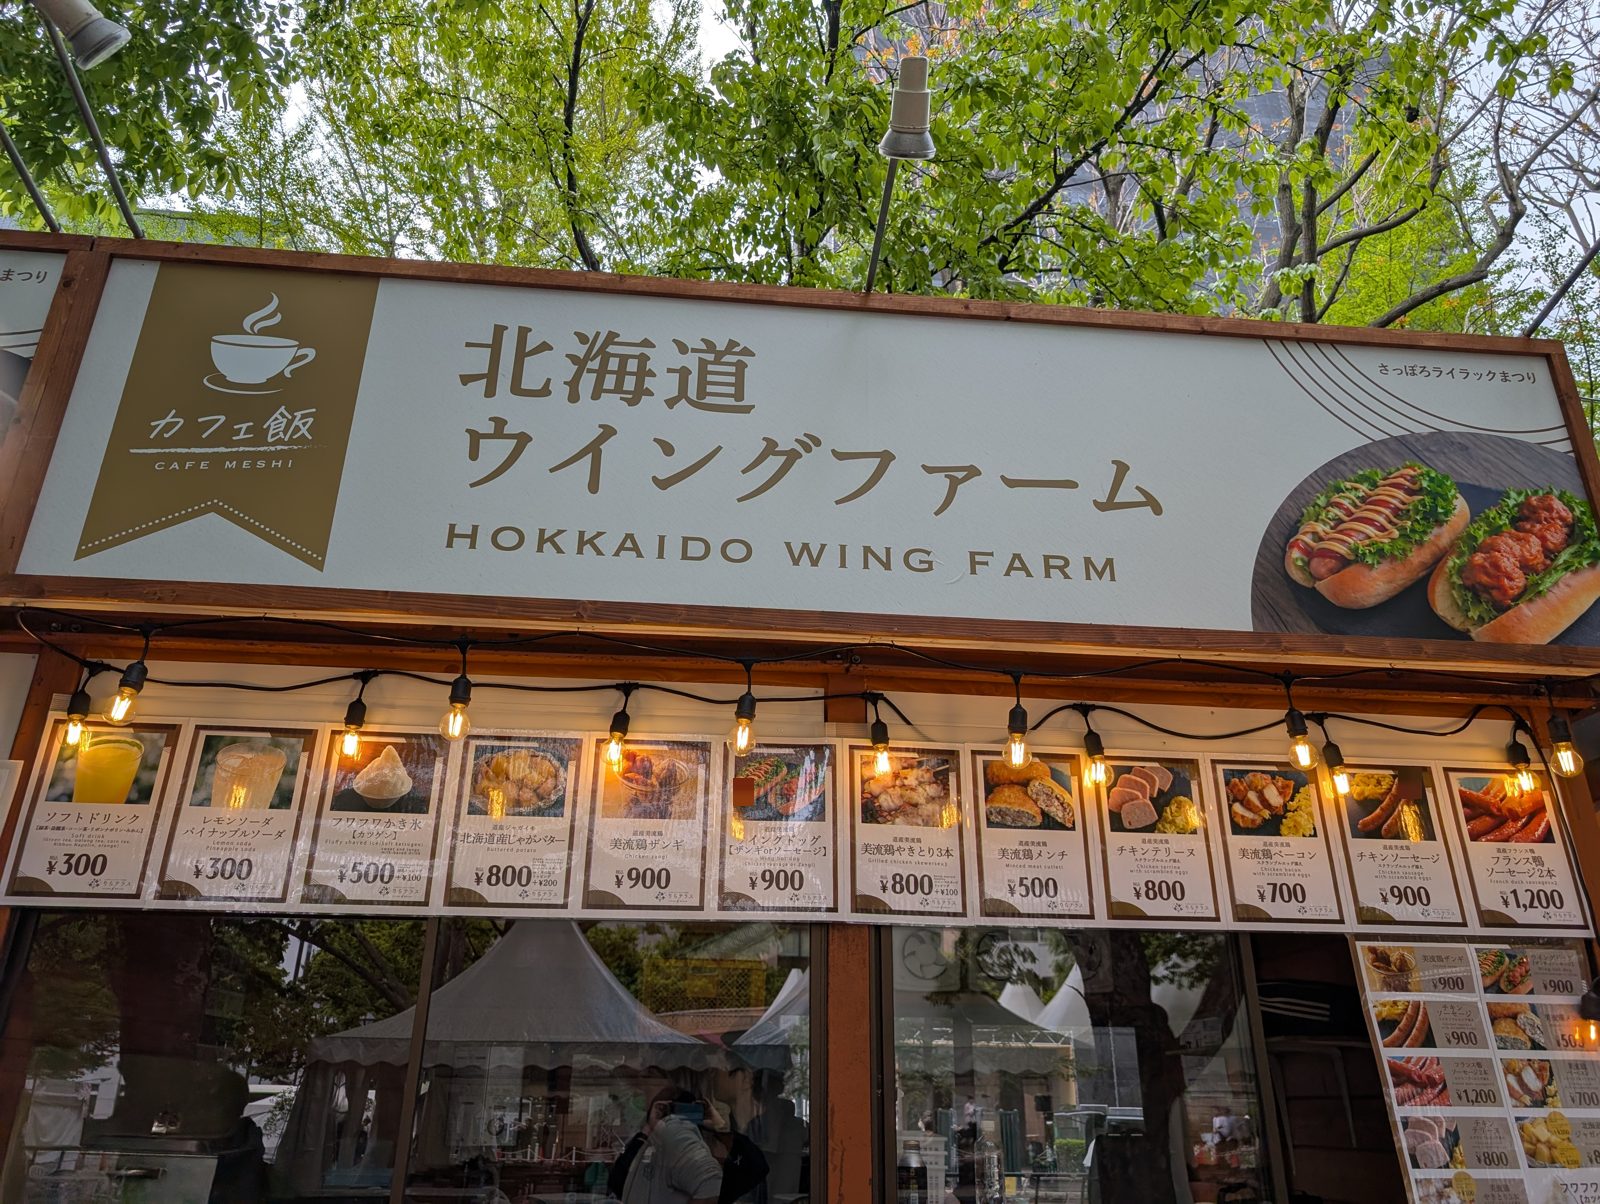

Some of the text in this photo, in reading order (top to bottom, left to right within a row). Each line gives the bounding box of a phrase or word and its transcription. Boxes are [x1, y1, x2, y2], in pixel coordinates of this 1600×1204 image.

[458, 323, 757, 415] 北海道
[1377, 362, 1537, 384] さっぽろライラックまつり
[149, 405, 317, 443] カフェ飯
[154, 459, 294, 470] CAFE MESHI
[465, 415, 1165, 517] ウイングファーム
[444, 523, 1119, 583] HOKKAIDO WING FARM
[45, 811, 140, 825] ソフトドリンク
[202, 816, 275, 828] レモンソーダ
[460, 832, 566, 846] 北海道産じゃがバター
[609, 838, 685, 851] 美流鶏ザンギ
[861, 842, 954, 859] 美流鶏やきとり3本
[997, 847, 1068, 861] 美流鶏メンチ
[1117, 845, 1196, 858] チキンテリーヌ
[1238, 847, 1317, 860] 美流鶏ベーコン
[1357, 851, 1440, 864] チキンソーセージ
[46, 853, 108, 877] ¥300
[193, 857, 253, 881] ¥300
[1491, 855, 1545, 868] フランス鴨
[337, 862, 395, 885] ¥500
[474, 864, 532, 888] ¥800
[615, 867, 671, 890] ¥900
[749, 869, 805, 891] ¥900
[1486, 867, 1557, 879] ソーセージ2本
[880, 872, 933, 896] ¥800
[1008, 876, 1058, 898] ¥500
[1133, 879, 1186, 902] ¥800
[1257, 882, 1307, 904] ¥700
[1379, 884, 1432, 907] ¥900
[1500, 888, 1565, 913] ¥1,200
[1432, 976, 1465, 991] ¥900
[1543, 979, 1574, 993] ¥900
[1445, 1031, 1478, 1046] ¥900
[1456, 1088, 1497, 1106] ¥1,200
[1475, 1151, 1509, 1167] ¥800
